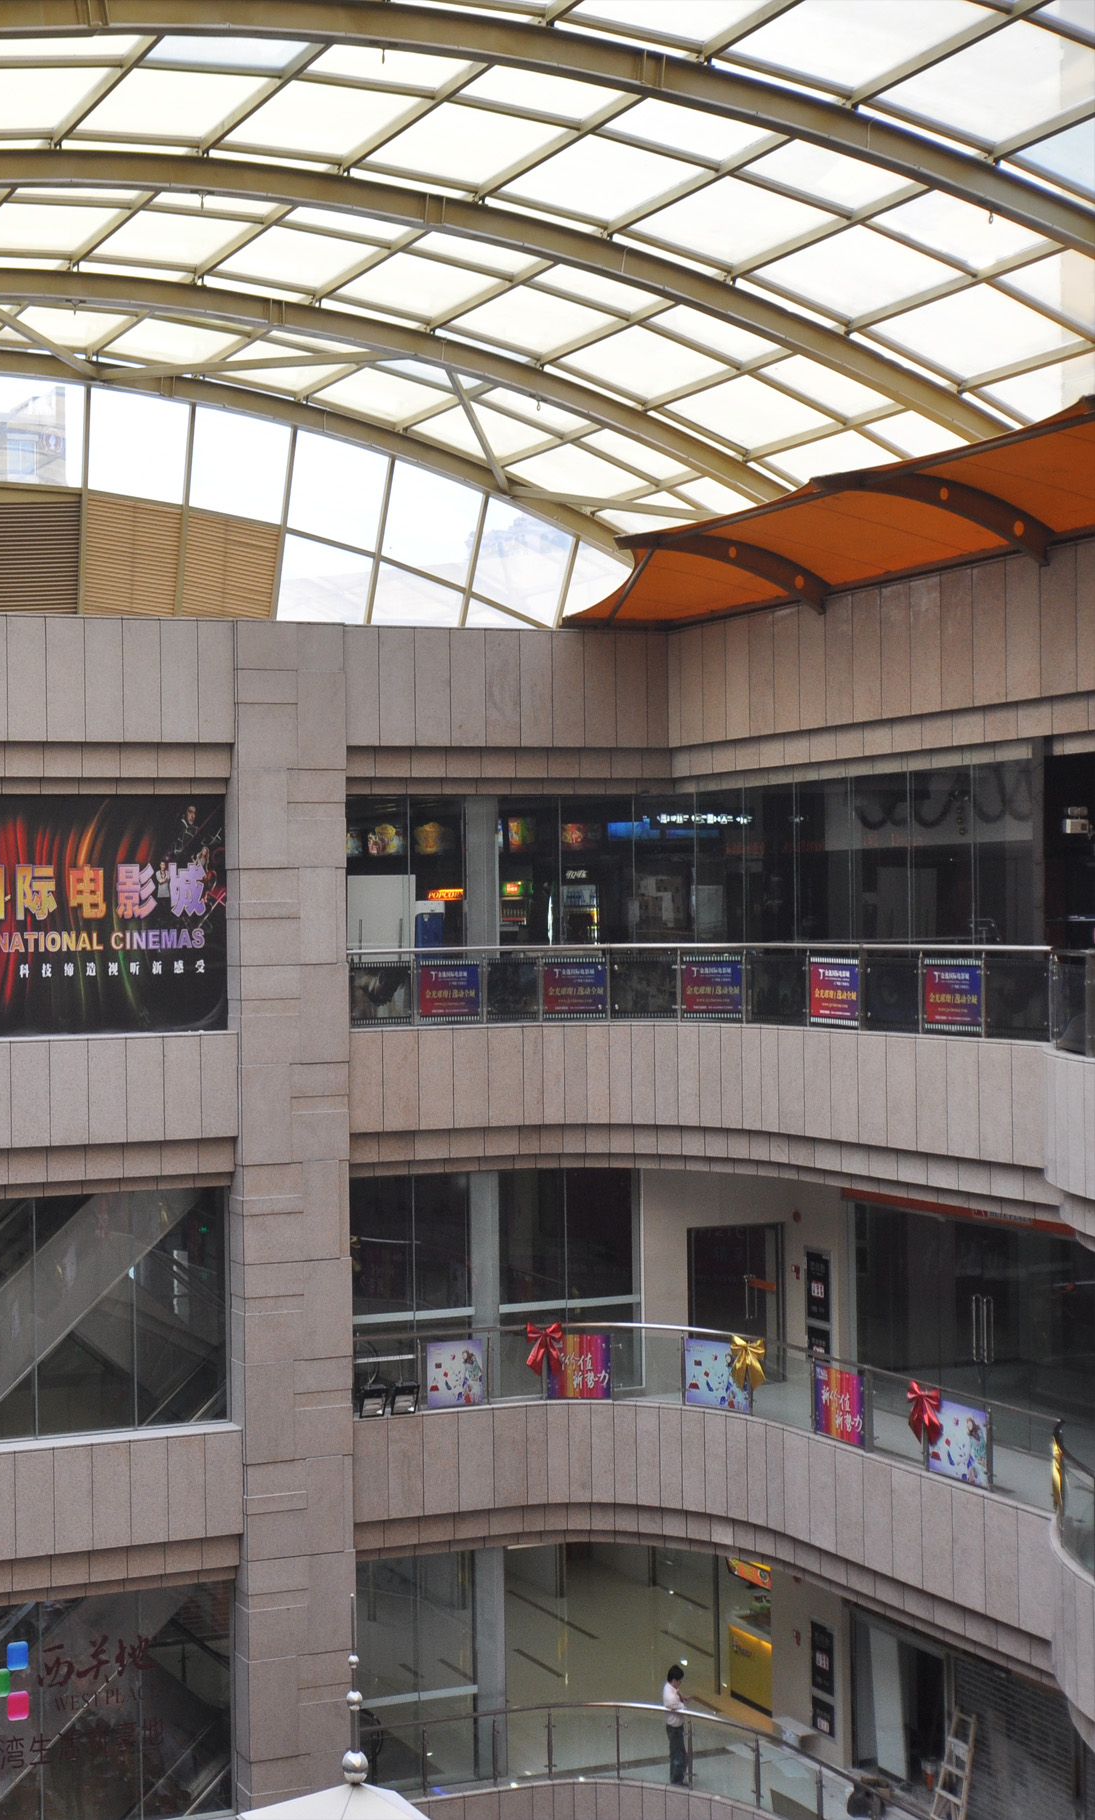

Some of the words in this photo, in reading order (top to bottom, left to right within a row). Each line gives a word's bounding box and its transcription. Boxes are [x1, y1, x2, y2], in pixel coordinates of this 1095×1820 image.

[111, 928, 206, 951] CINEMAS
[18, 959, 206, 979] 科技缔造视听新感受
[572, 1369, 609, 1390] 新势力
[835, 1411, 863, 1433] 新势力
[54, 1691, 100, 1712] WEST
[105, 1683, 161, 1705] PLACE
